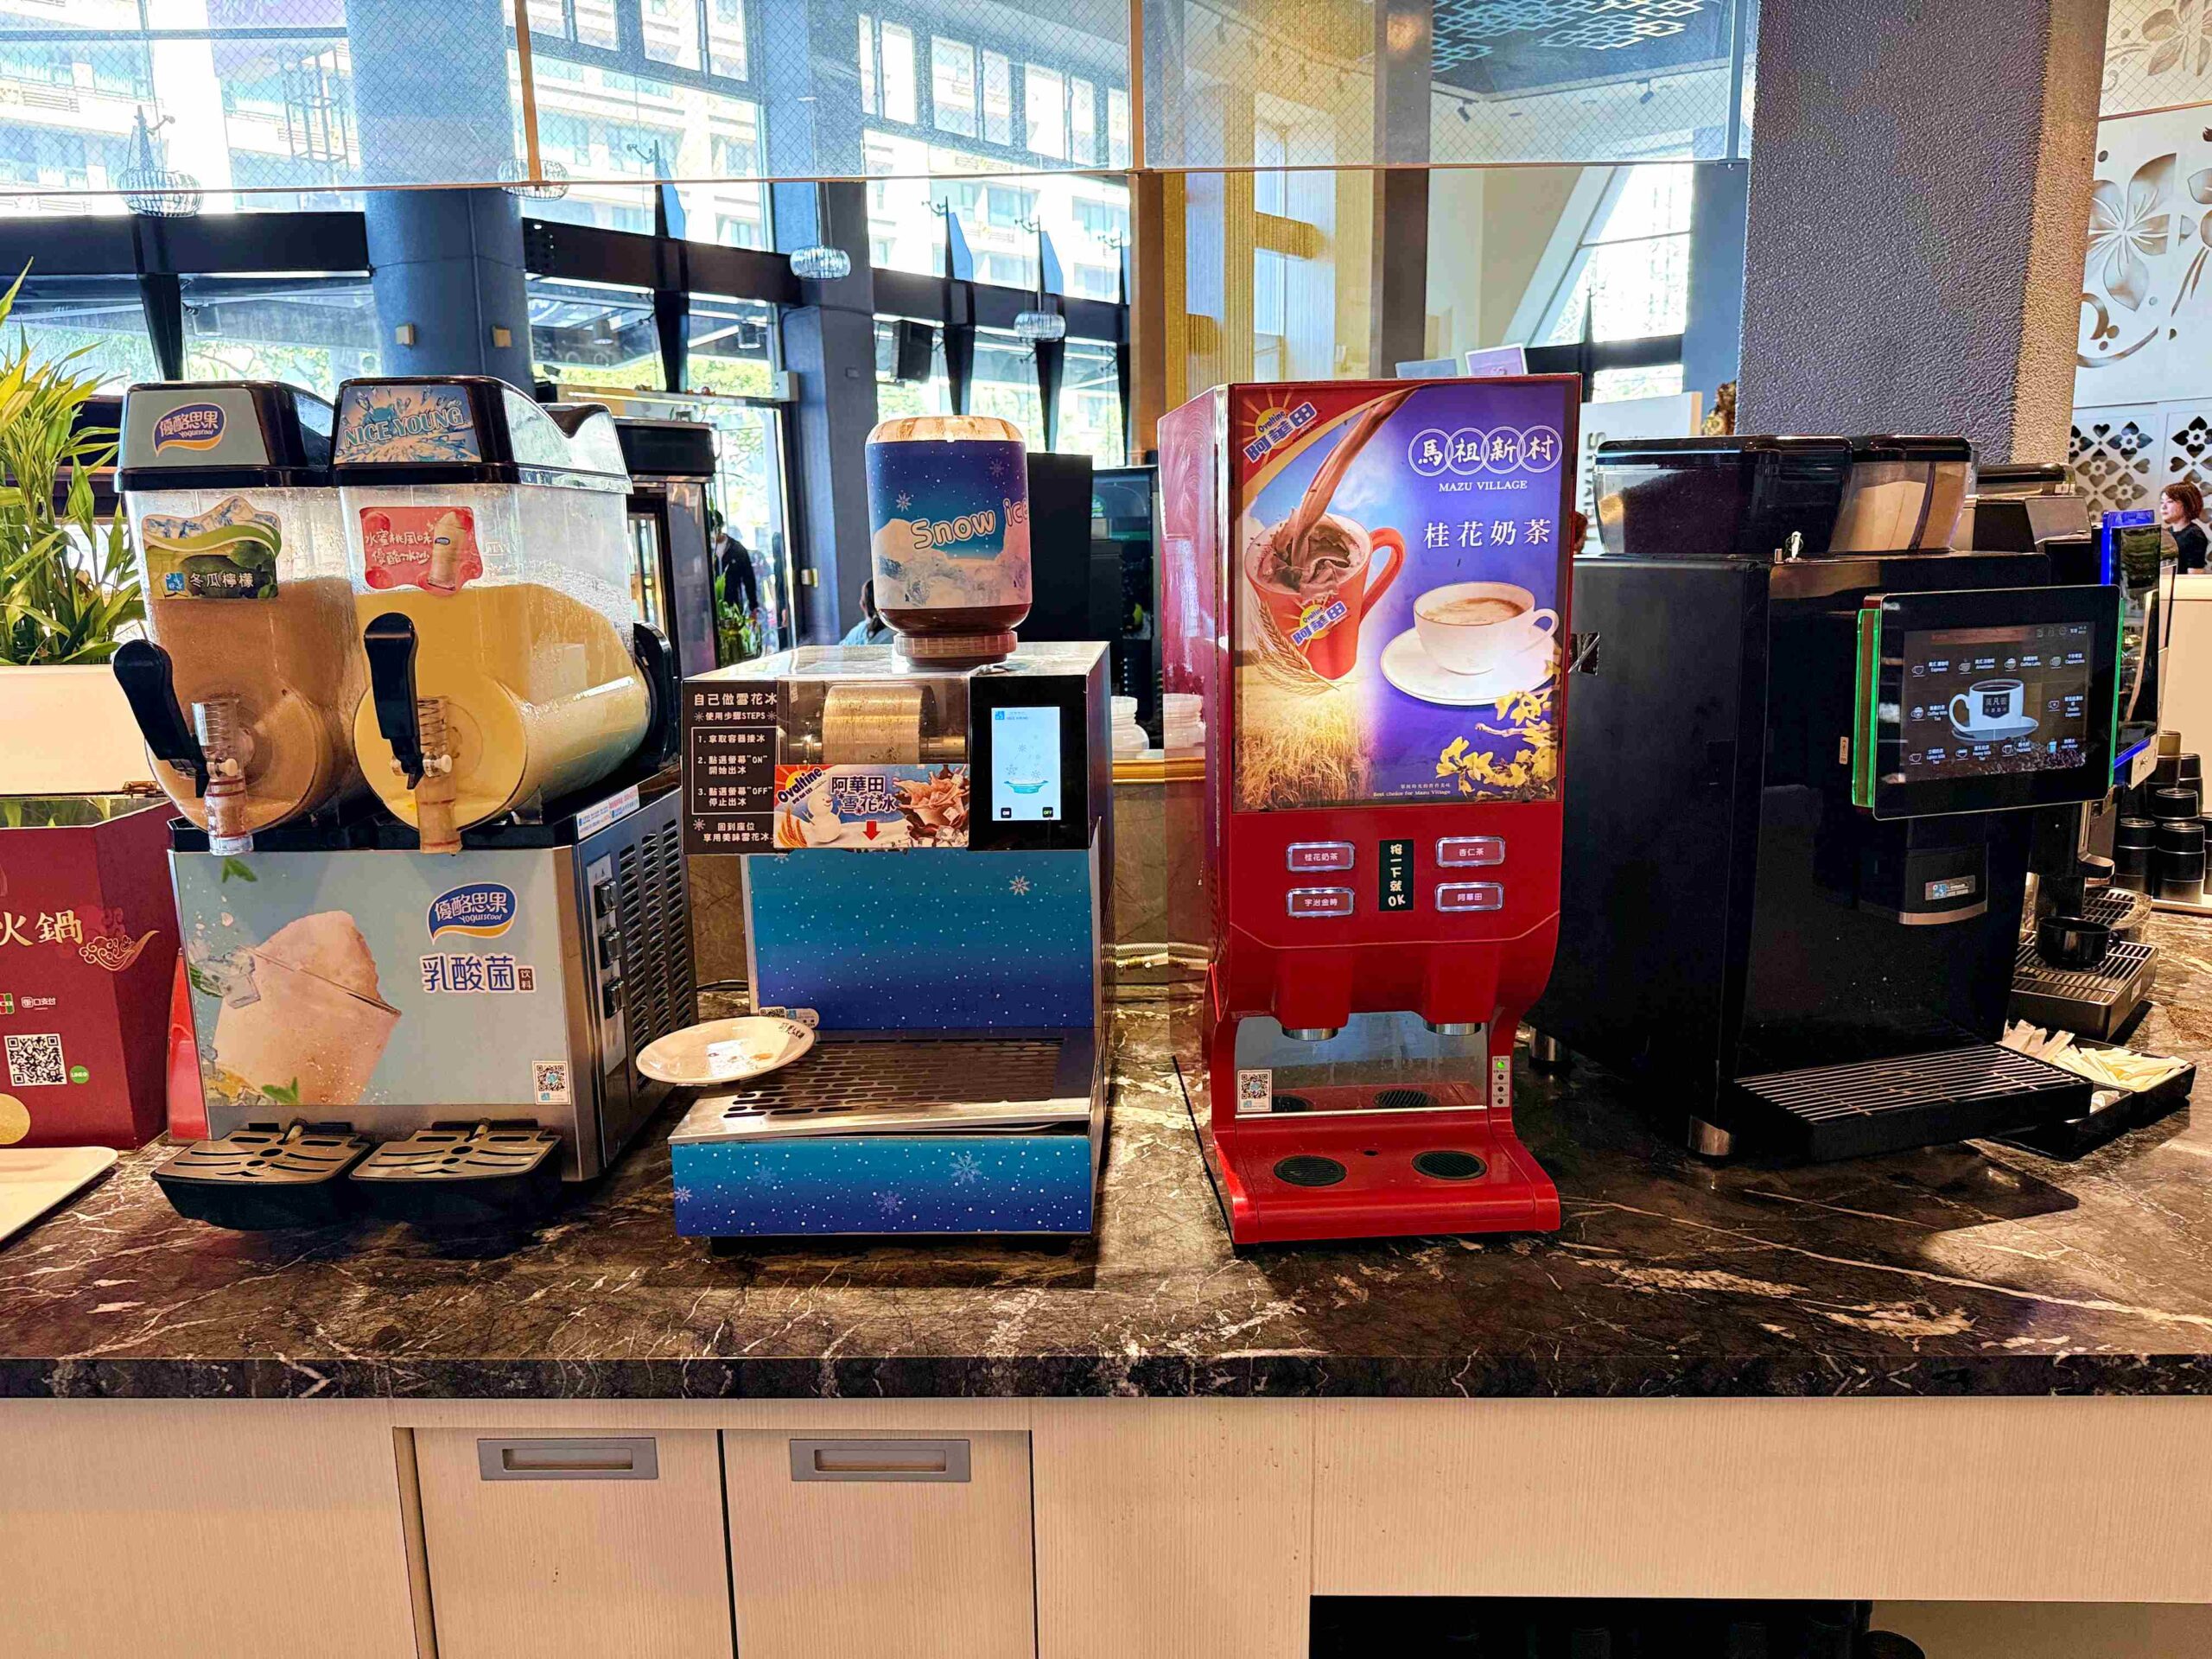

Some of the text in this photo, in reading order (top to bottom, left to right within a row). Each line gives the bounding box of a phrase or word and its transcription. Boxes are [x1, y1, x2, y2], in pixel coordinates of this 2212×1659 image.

[159, 410, 219, 437] 優酪思果
[343, 406, 465, 448] NICE YOUNG
[1257, 410, 1287, 434] Ovaltine
[1243, 402, 1318, 464] 阿華田
[1417, 434, 1555, 467] 馬祖新村
[1438, 480, 1529, 493] MAZU VILLAGE
[365, 529, 432, 547] 水蜜桃風味
[910, 509, 995, 550] Snow
[1423, 518, 1552, 549] 桂花奶茶
[189, 572, 255, 589] 冬瓜檸檬
[694, 692, 778, 706] 自己做雪花冰
[709, 766, 747, 775] 開始出冰
[777, 767, 823, 804] Ovaltine
[831, 777, 886, 793] 阿華田
[709, 798, 747, 807] 停止出冰
[842, 794, 896, 813] 雪花冰
[717, 822, 755, 831] 回到座位
[702, 832, 769, 842] 享用美味雪花冰
[1304, 852, 1338, 861] 桂花奶茶
[1459, 848, 1484, 857] 杏仁茶
[434, 892, 508, 922] 優酪思果
[1457, 893, 1483, 902] 阿華田
[0, 909, 83, 947] 火鍋
[422, 955, 516, 991] 乳酸菌
[519, 969, 532, 990] 饮料
